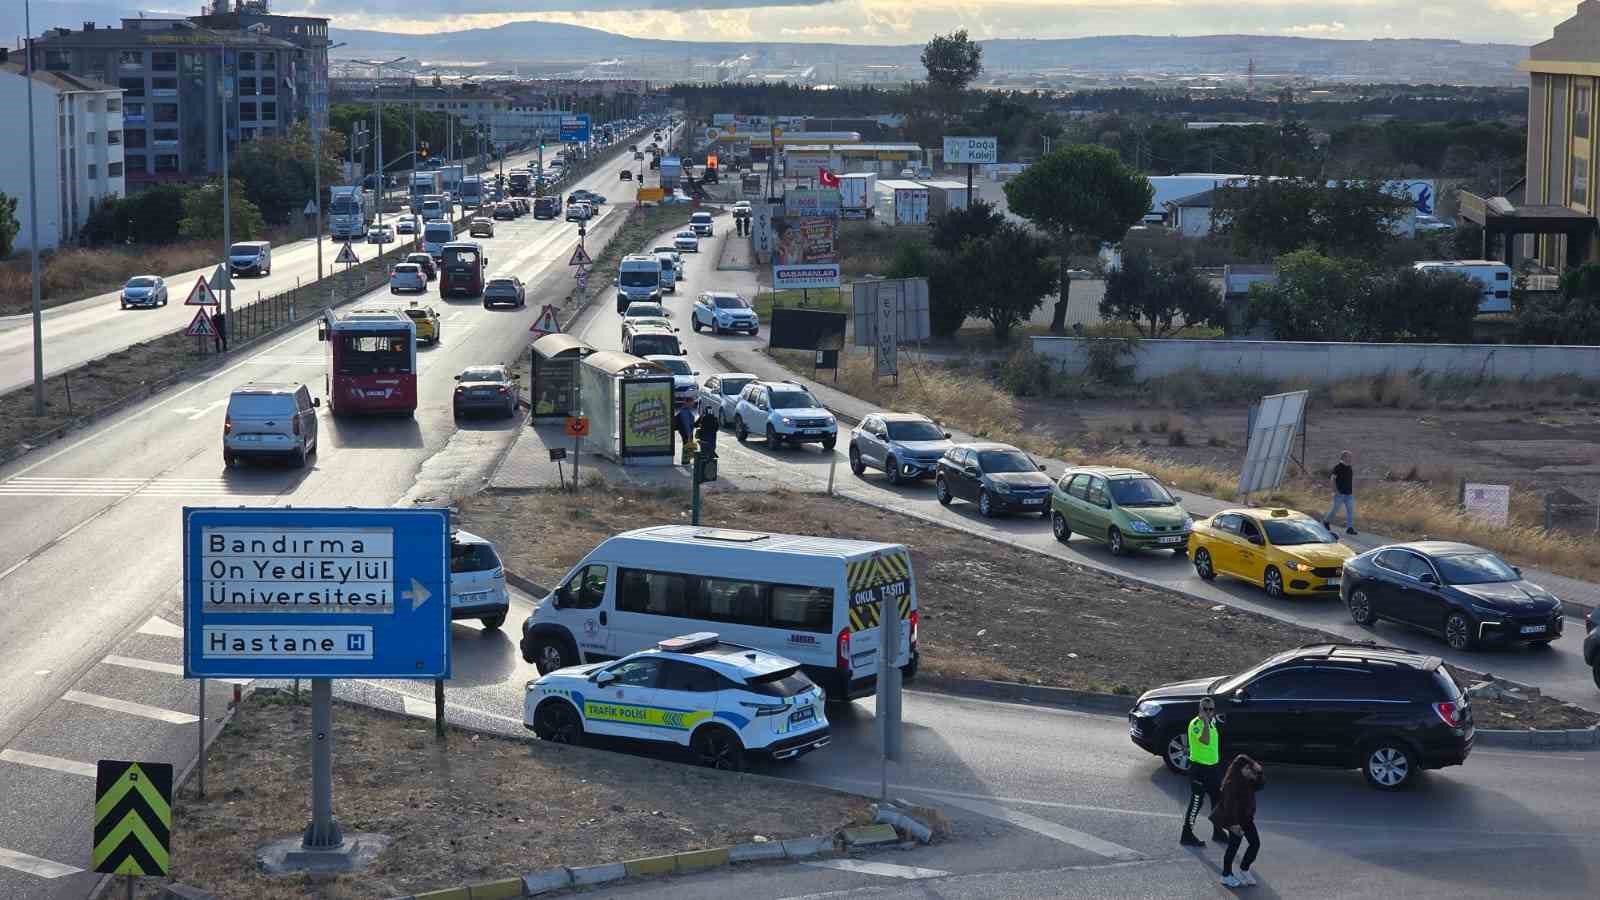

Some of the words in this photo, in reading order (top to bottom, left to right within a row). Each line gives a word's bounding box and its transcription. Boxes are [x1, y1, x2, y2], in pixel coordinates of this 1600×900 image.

[209, 534, 365, 553] Bandırma
[209, 582, 387, 605] Üniversitesi
[855, 589, 876, 604] OKUL
[210, 633, 335, 651] Hastane
[350, 635, 363, 650] H
